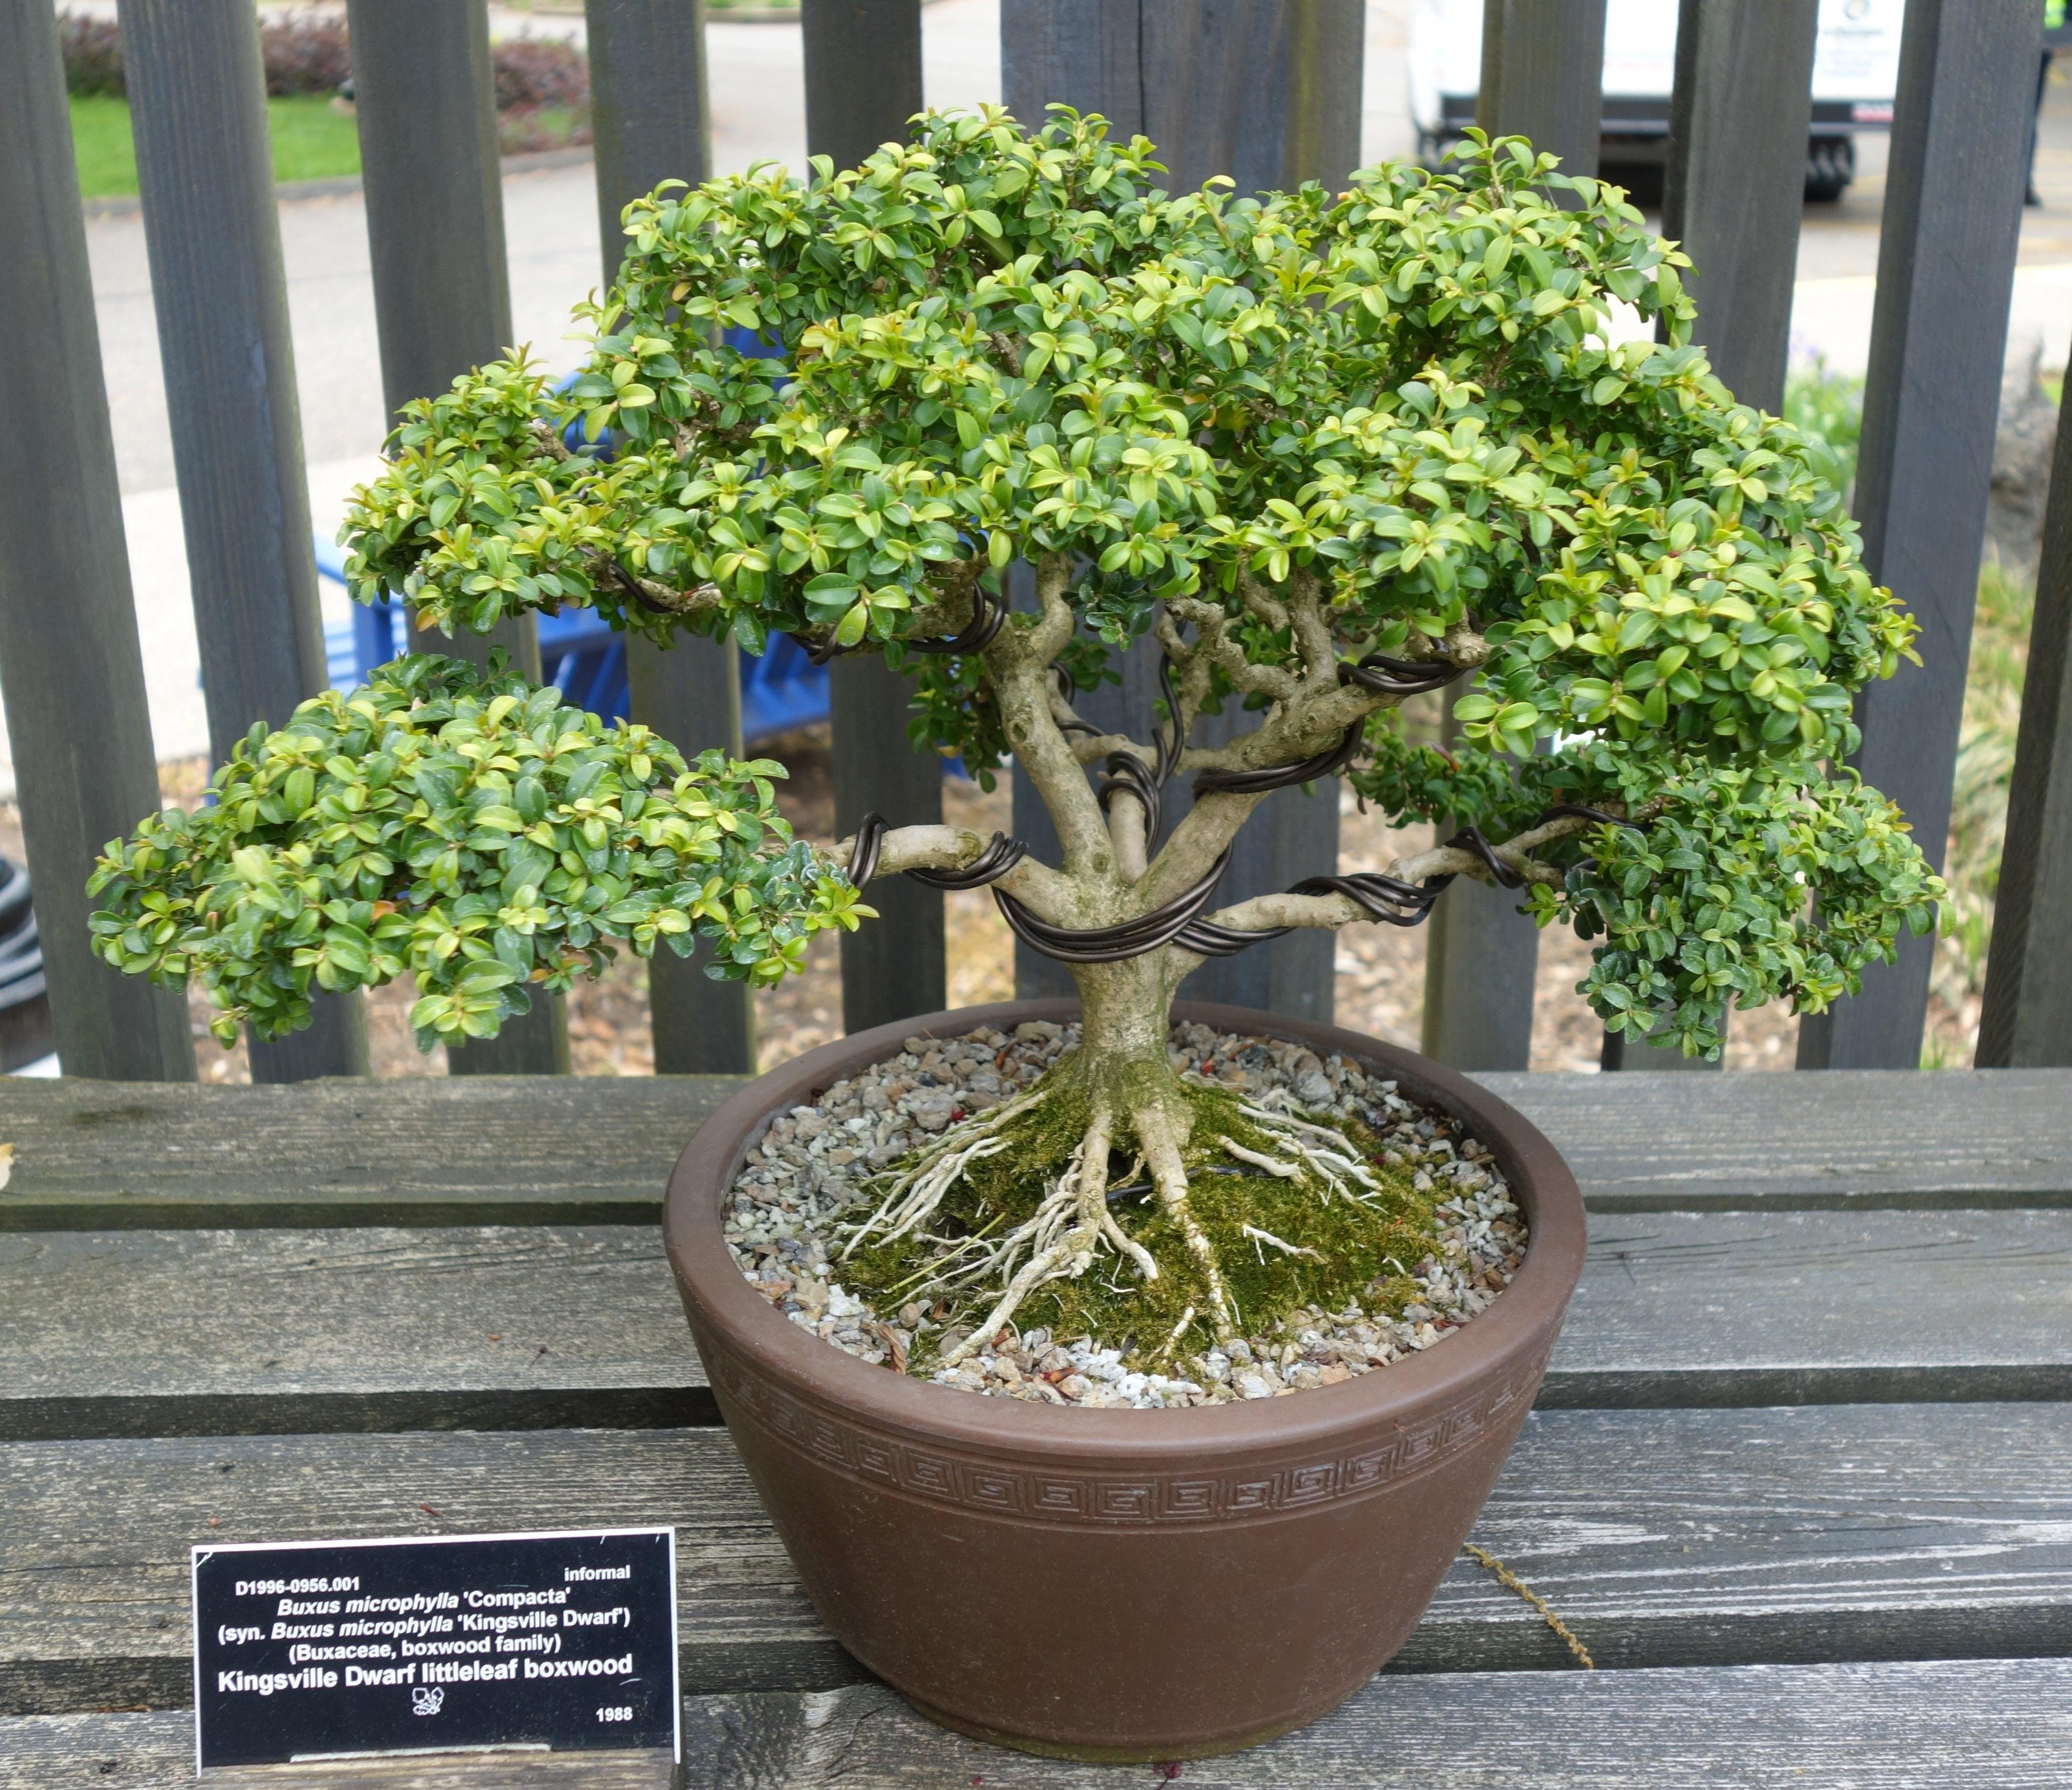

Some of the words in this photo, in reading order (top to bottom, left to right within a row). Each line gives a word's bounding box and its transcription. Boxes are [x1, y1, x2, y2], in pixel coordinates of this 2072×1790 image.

[236, 1576, 360, 1595] D1996-0956.001
[564, 1565, 630, 1581] informal
[277, 1599, 341, 1616] Buxus
[345, 1592, 459, 1614] microphylla
[463, 1586, 571, 1609] 'Compacta'
[218, 1625, 265, 1646] (syn.
[270, 1622, 335, 1640] Buxus
[338, 1615, 454, 1638] microphylla
[457, 1611, 558, 1633] 'Kingsville
[563, 1607, 630, 1627] Dwarf')
[289, 1643, 397, 1665] (Buxaceae,
[401, 1635, 491, 1658] boxwood
[495, 1633, 561, 1654] family)
[218, 1667, 338, 1696] Kingsville
[345, 1662, 417, 1687] Dwarf
[422, 1658, 519, 1683] littleleaf
[524, 1653, 633, 1679] boxwood
[596, 1706, 633, 1722] 1988
